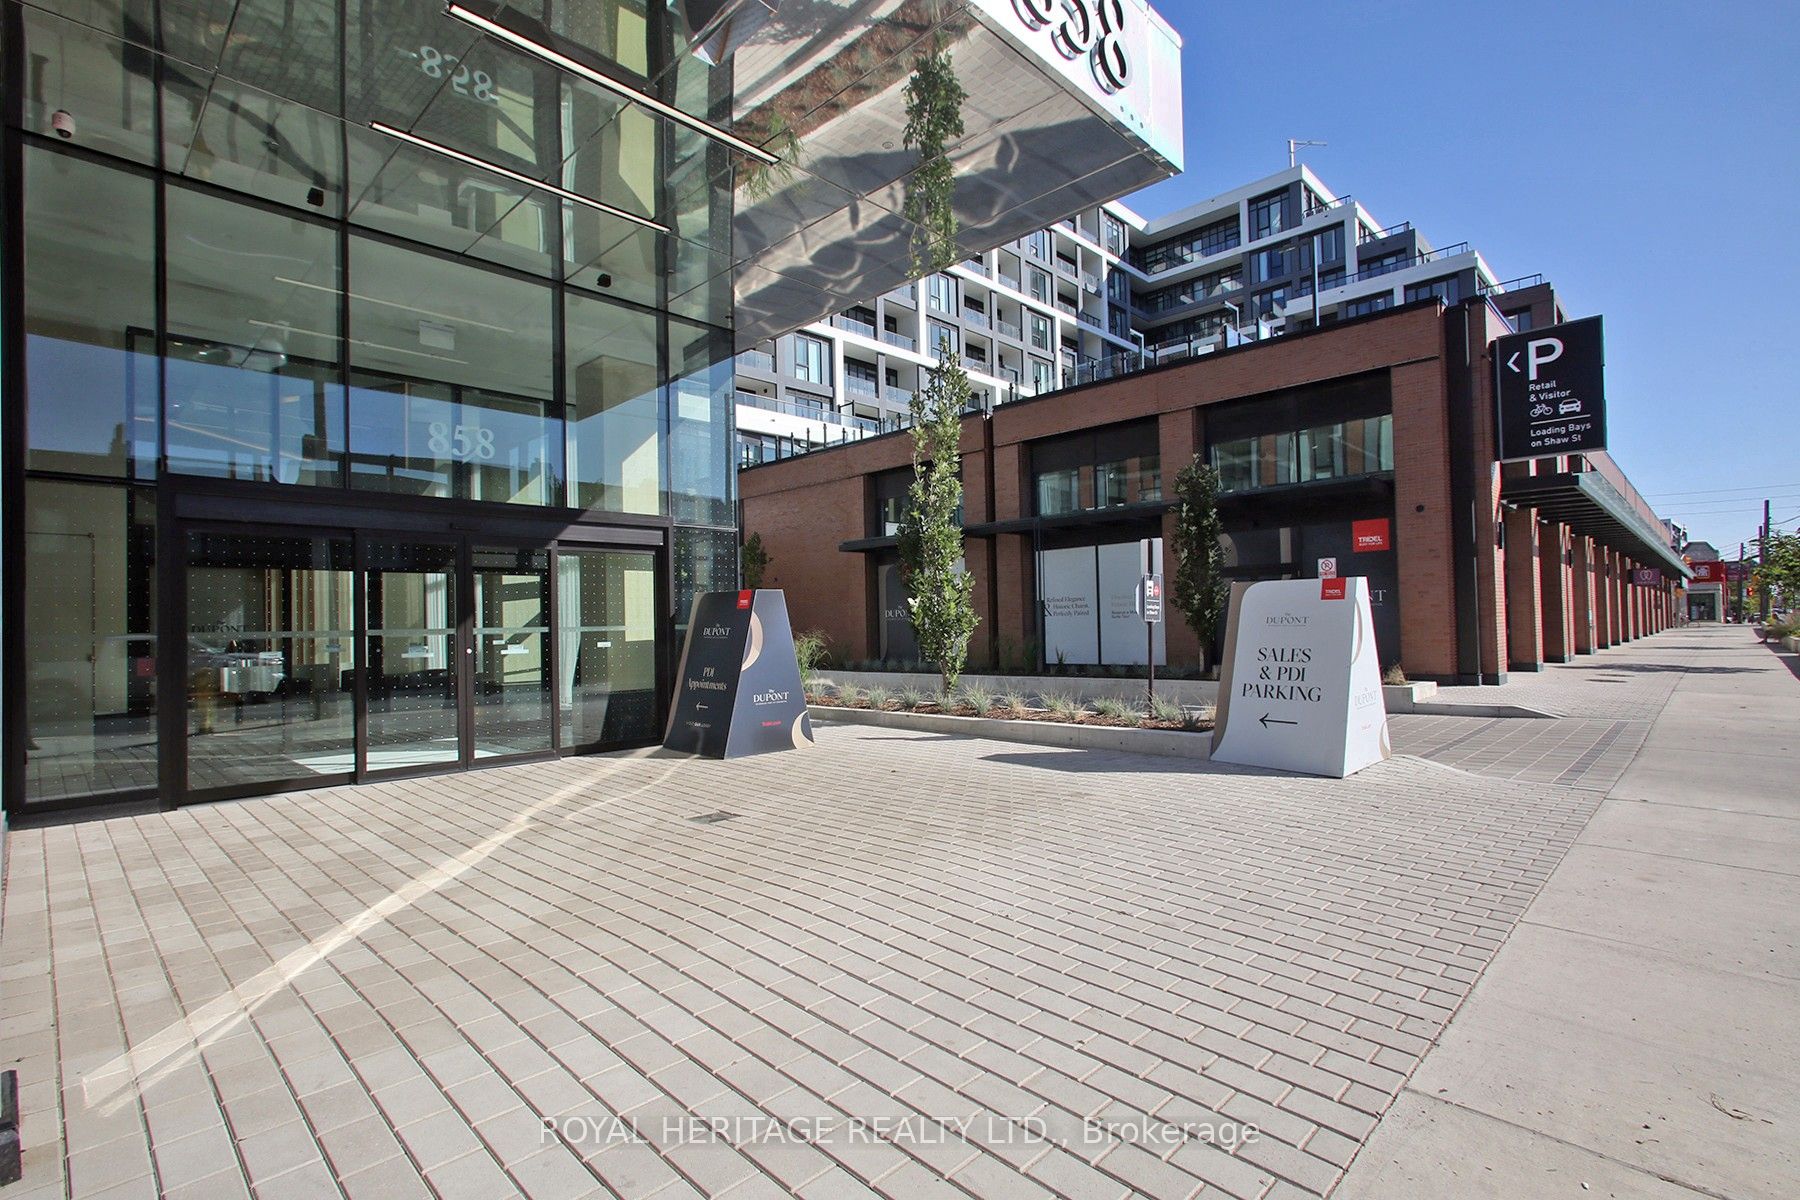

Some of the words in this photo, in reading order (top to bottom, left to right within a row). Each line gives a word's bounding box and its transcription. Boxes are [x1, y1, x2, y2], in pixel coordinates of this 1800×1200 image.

[1528, 337, 1564, 381] P
[1529, 380, 1557, 392] Retail
[1529, 393, 1537, 402] &
[1539, 390, 1571, 401] Visitor
[1530, 426, 1566, 437] Loading
[1568, 422, 1591, 432] Bays
[427, 422, 495, 459] 858
[1531, 440, 1542, 448] on
[1544, 436, 1569, 446] Shaw
[1571, 434, 1582, 442] St
[1265, 616, 1310, 624] DUPONT
[703, 627, 731, 636] DUPONT
[1257, 647, 1312, 663] SALES
[703, 666, 715, 677] PDI
[1259, 666, 1271, 681] &
[1277, 666, 1307, 682] PDI
[753, 692, 789, 703] DUPONT
[1242, 683, 1322, 703] PARKING
